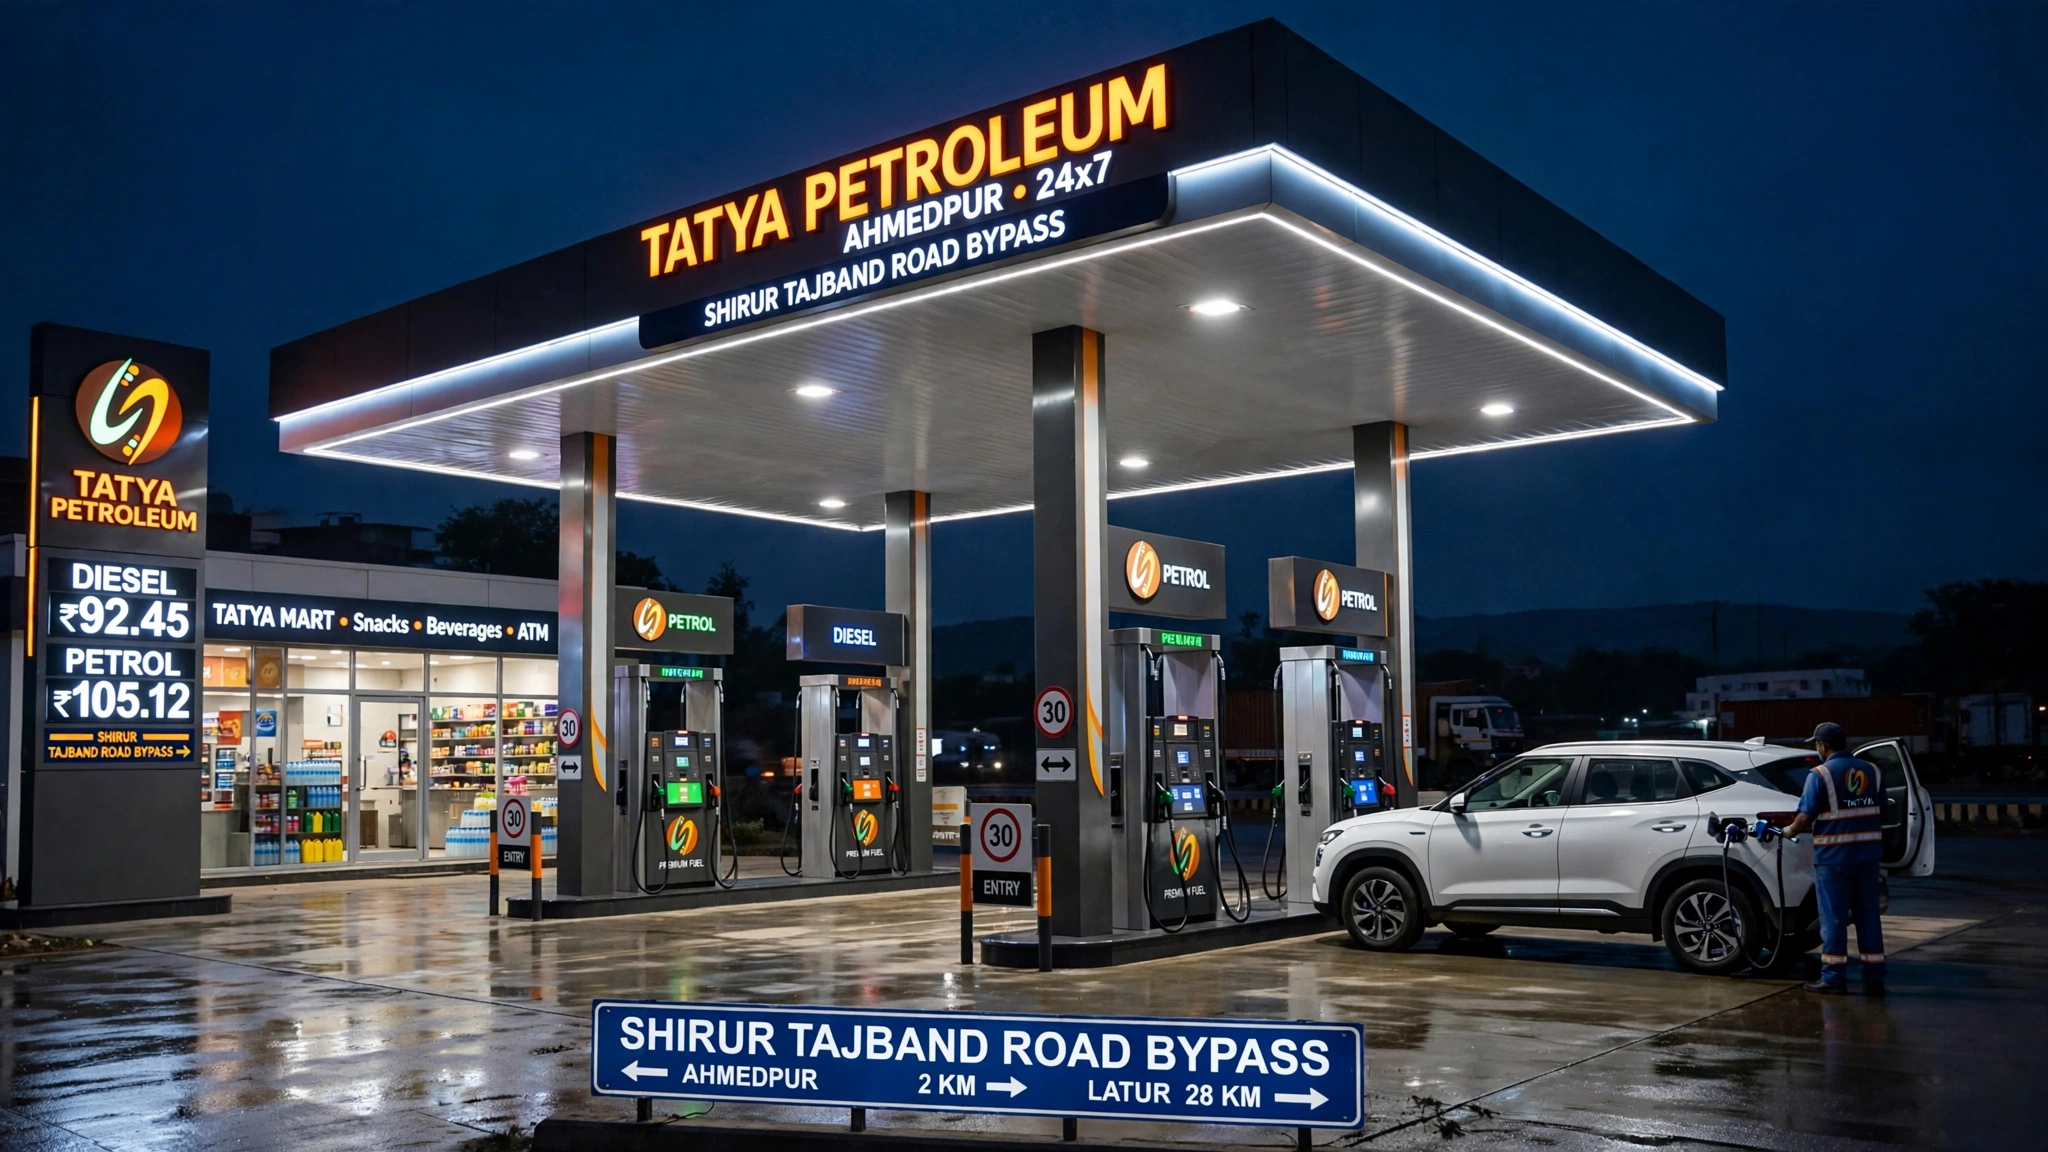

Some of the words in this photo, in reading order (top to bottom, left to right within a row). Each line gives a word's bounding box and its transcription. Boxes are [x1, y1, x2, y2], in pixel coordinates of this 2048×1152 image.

[642, 189, 789, 276] TATYA
[806, 64, 1166, 231] PETROLEUM
[844, 183, 1003, 253] AHMEDPUR
[1037, 151, 1112, 200] 24x7
[705, 287, 778, 326] SHIRUR
[784, 259, 884, 305] TAJBAND
[892, 239, 959, 278] ROAD
[967, 210, 1065, 259] BYPASS
[73, 470, 177, 507] TATYA
[51, 497, 197, 532] PETROLEUM
[73, 563, 176, 595] DIESEL
[1164, 565, 1210, 589] PETROL
[1342, 590, 1377, 610] PETROL
[59, 596, 190, 638] ₹92.45
[213, 603, 275, 627] TATYA
[281, 607, 335, 630] MART
[354, 613, 409, 633] Snacks
[427, 616, 502, 642] Beverages
[518, 623, 548, 641] ATM
[669, 614, 715, 631] PETROL
[834, 627, 876, 645] DIESEL
[66, 648, 180, 676] PETROL
[53, 680, 190, 719] ₹105.12
[1043, 700, 1066, 723] 30
[98, 731, 137, 743] SHIRUR
[562, 719, 576, 737] 30
[48, 746, 99, 758] TAJBAND
[101, 746, 132, 758] ROAD
[134, 745, 173, 758] BYPASS
[507, 809, 521, 827] 30
[989, 824, 1013, 847] 30
[503, 851, 525, 863] ENTRY
[983, 879, 1020, 896] ENTRY
[621, 1017, 775, 1055] SHIRUR
[790, 1023, 987, 1063] TAJBAND
[1004, 1031, 1130, 1068] ROAD
[1148, 1036, 1329, 1075] BYPASS
[683, 1064, 818, 1089] AHMEDPUR
[919, 1074, 930, 1093] 2
[940, 1075, 975, 1095] KM
[1089, 1080, 1170, 1103] LATUR
[1186, 1084, 1213, 1105] 28
[1223, 1086, 1260, 1107] KM
